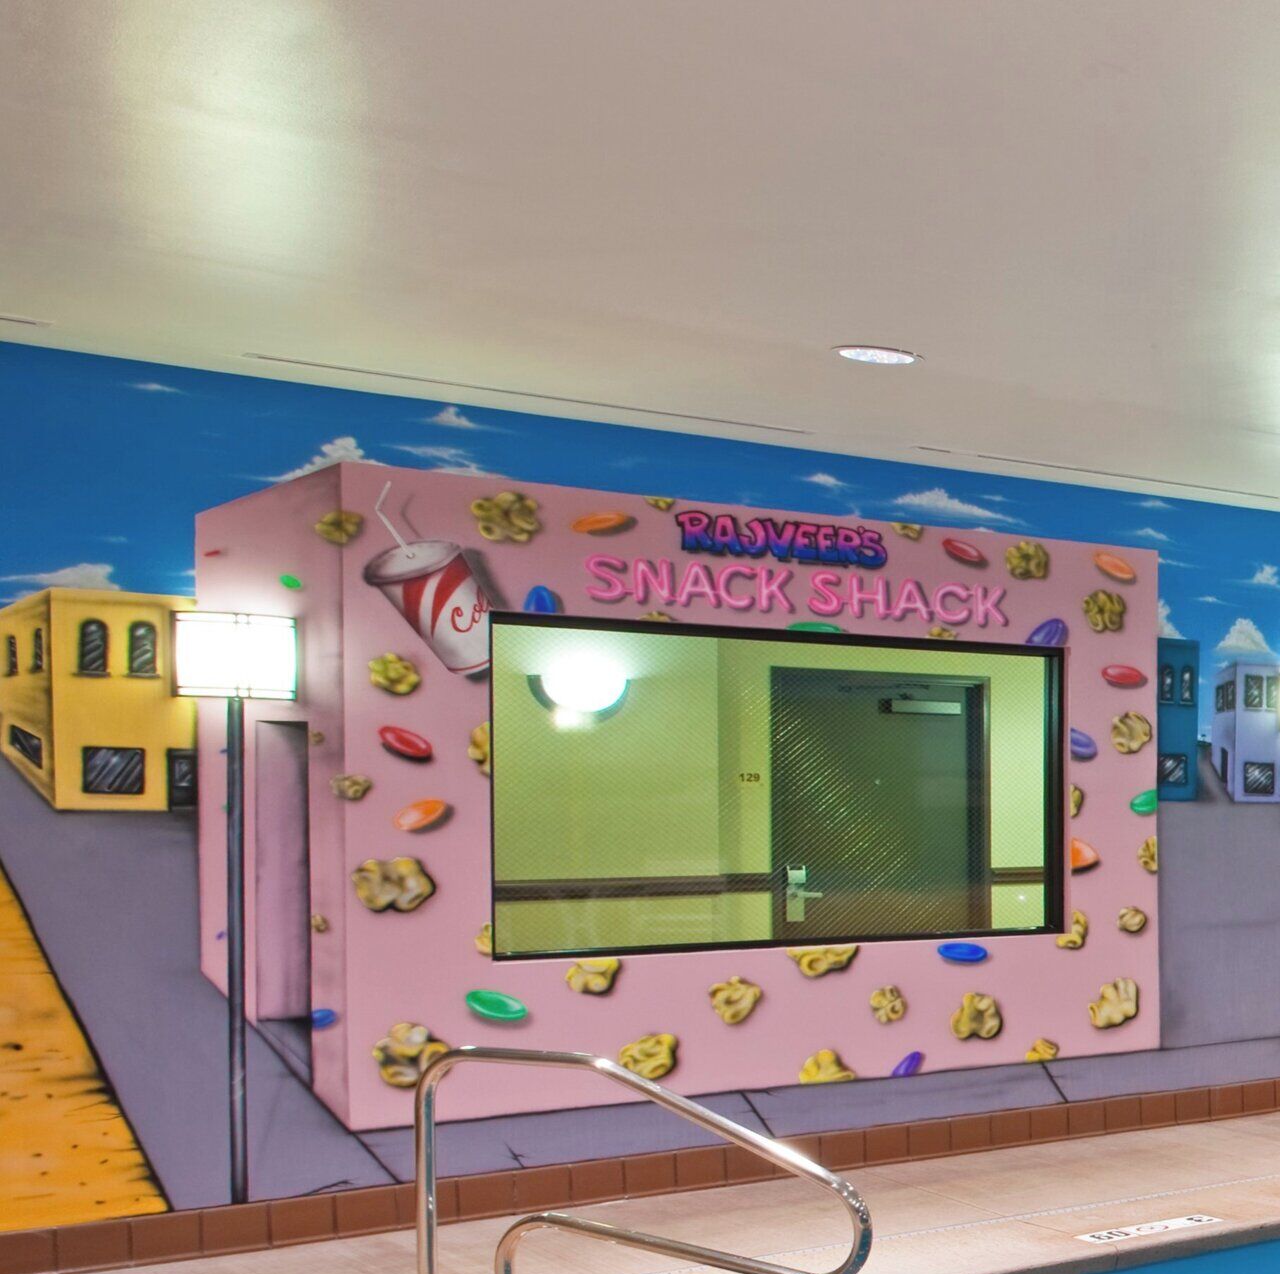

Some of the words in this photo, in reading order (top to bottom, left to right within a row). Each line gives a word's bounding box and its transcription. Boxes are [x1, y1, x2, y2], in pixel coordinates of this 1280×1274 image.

[675, 510, 888, 570] RAJVEER'S
[584, 553, 795, 613] SNACK
[806, 570, 1010, 627] SHACK
